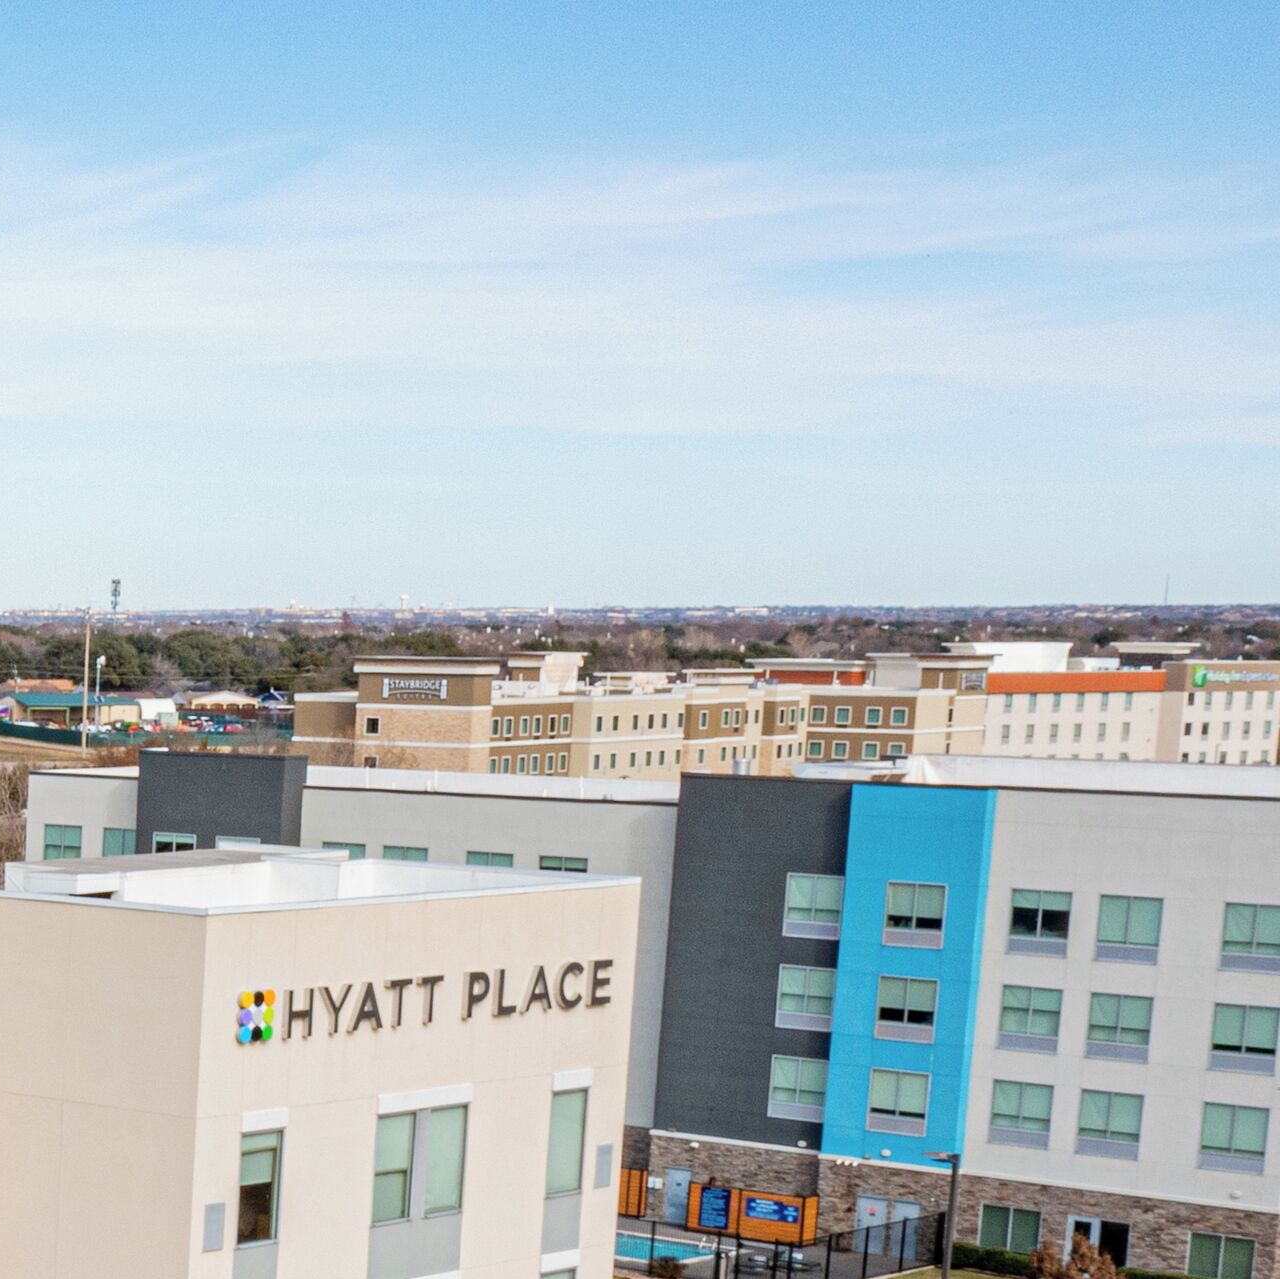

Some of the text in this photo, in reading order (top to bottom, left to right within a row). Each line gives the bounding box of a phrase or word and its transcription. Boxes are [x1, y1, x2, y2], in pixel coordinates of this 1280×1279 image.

[389, 679, 441, 689] STAYBRIDGE
[281, 959, 613, 1040] HYATT PLACE
